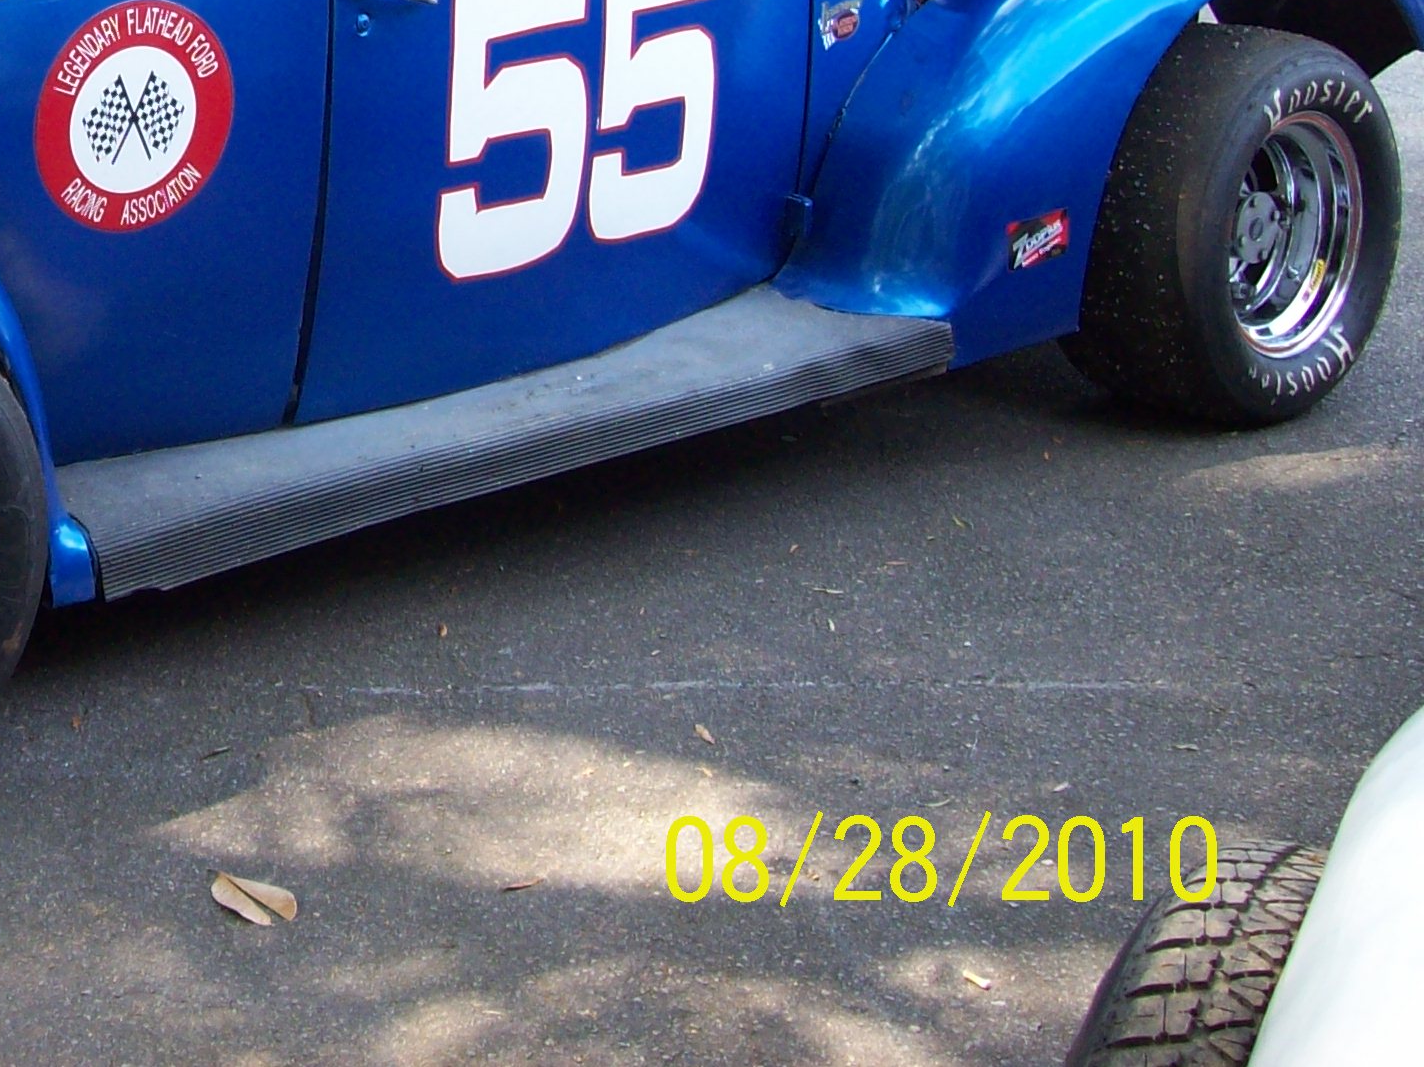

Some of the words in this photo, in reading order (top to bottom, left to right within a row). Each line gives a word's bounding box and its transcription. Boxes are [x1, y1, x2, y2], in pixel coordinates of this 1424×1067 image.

[53, 13, 121, 96] LEGENDARY
[126, 7, 194, 46] FLATHEAD
[185, 33, 219, 79] FORD
[1264, 70, 1374, 131] Hoosier
[60, 177, 108, 223] RACING
[120, 162, 202, 226] ASSOCIATION
